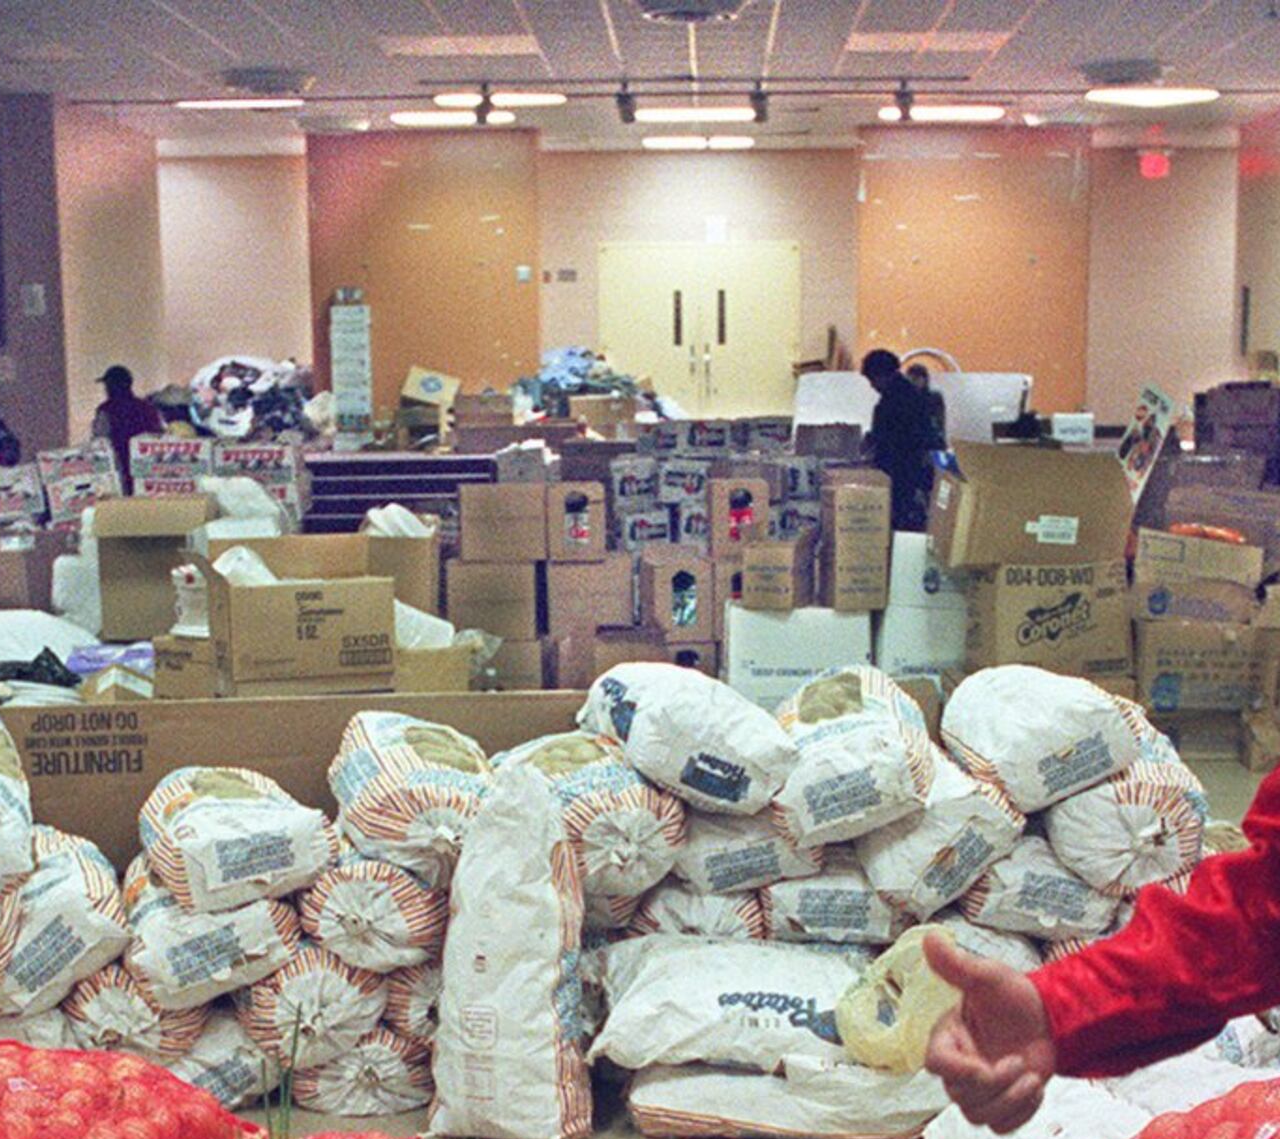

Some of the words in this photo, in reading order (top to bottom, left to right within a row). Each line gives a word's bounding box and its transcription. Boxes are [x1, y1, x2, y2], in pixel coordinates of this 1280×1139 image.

[30, 713, 76, 733] DROP
[81, 712, 112, 732] NOT
[115, 711, 139, 731] DO
[31, 750, 143, 777] FURNITURE
[717, 991, 816, 1028] Potatoes
